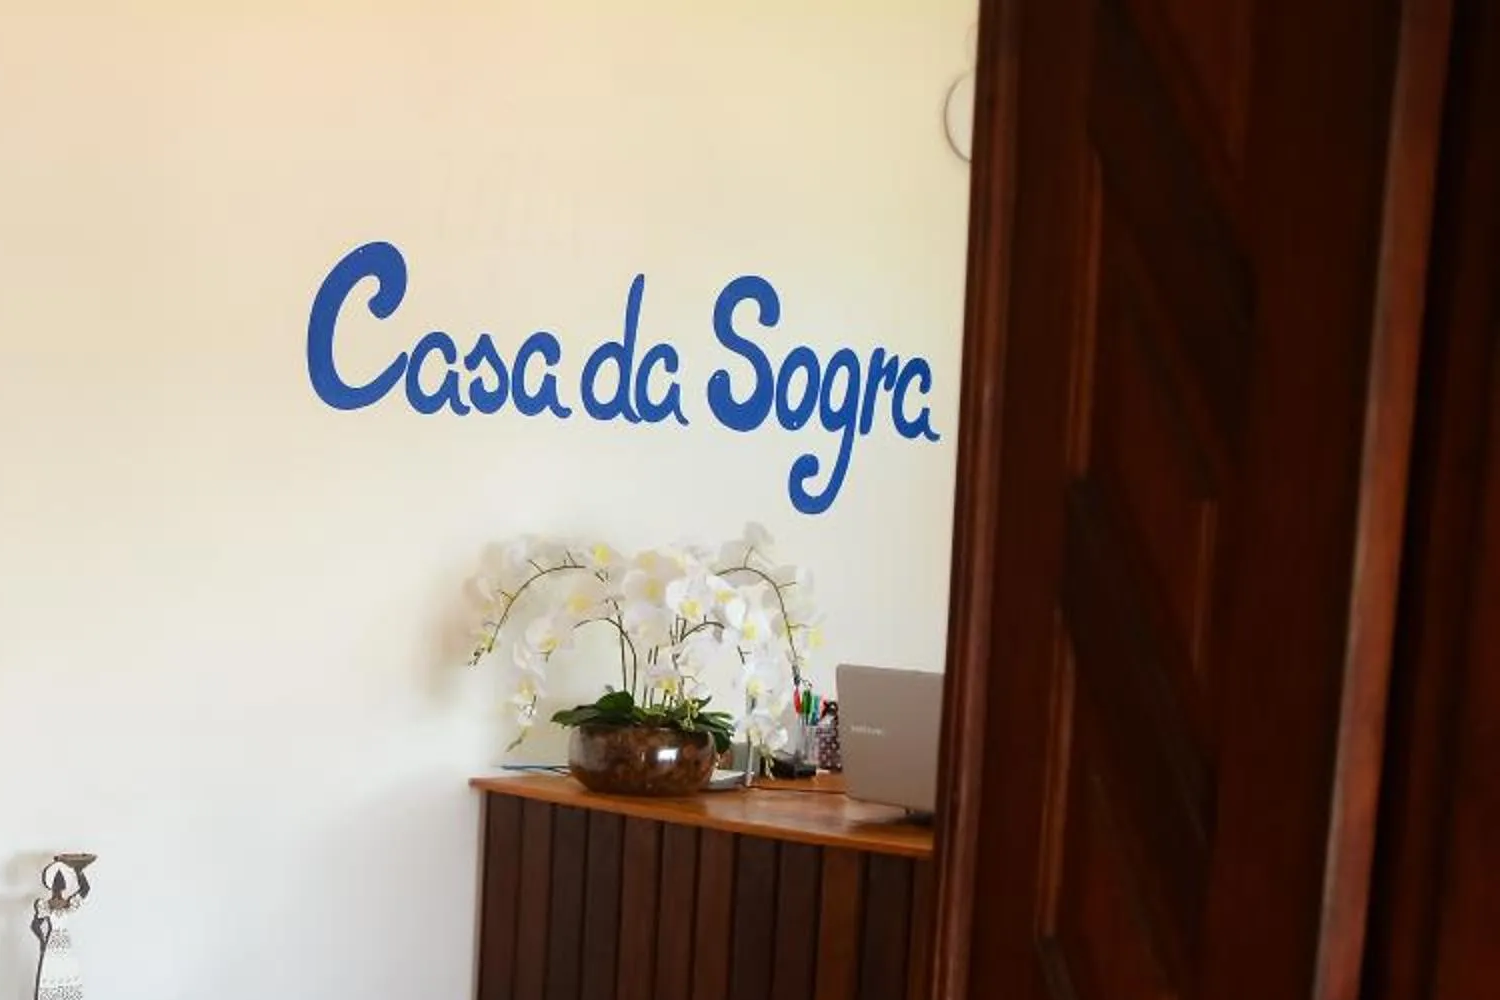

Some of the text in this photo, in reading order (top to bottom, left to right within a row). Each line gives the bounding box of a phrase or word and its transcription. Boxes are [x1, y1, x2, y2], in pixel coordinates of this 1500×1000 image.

[306, 241, 940, 515] Casa da Sogra
